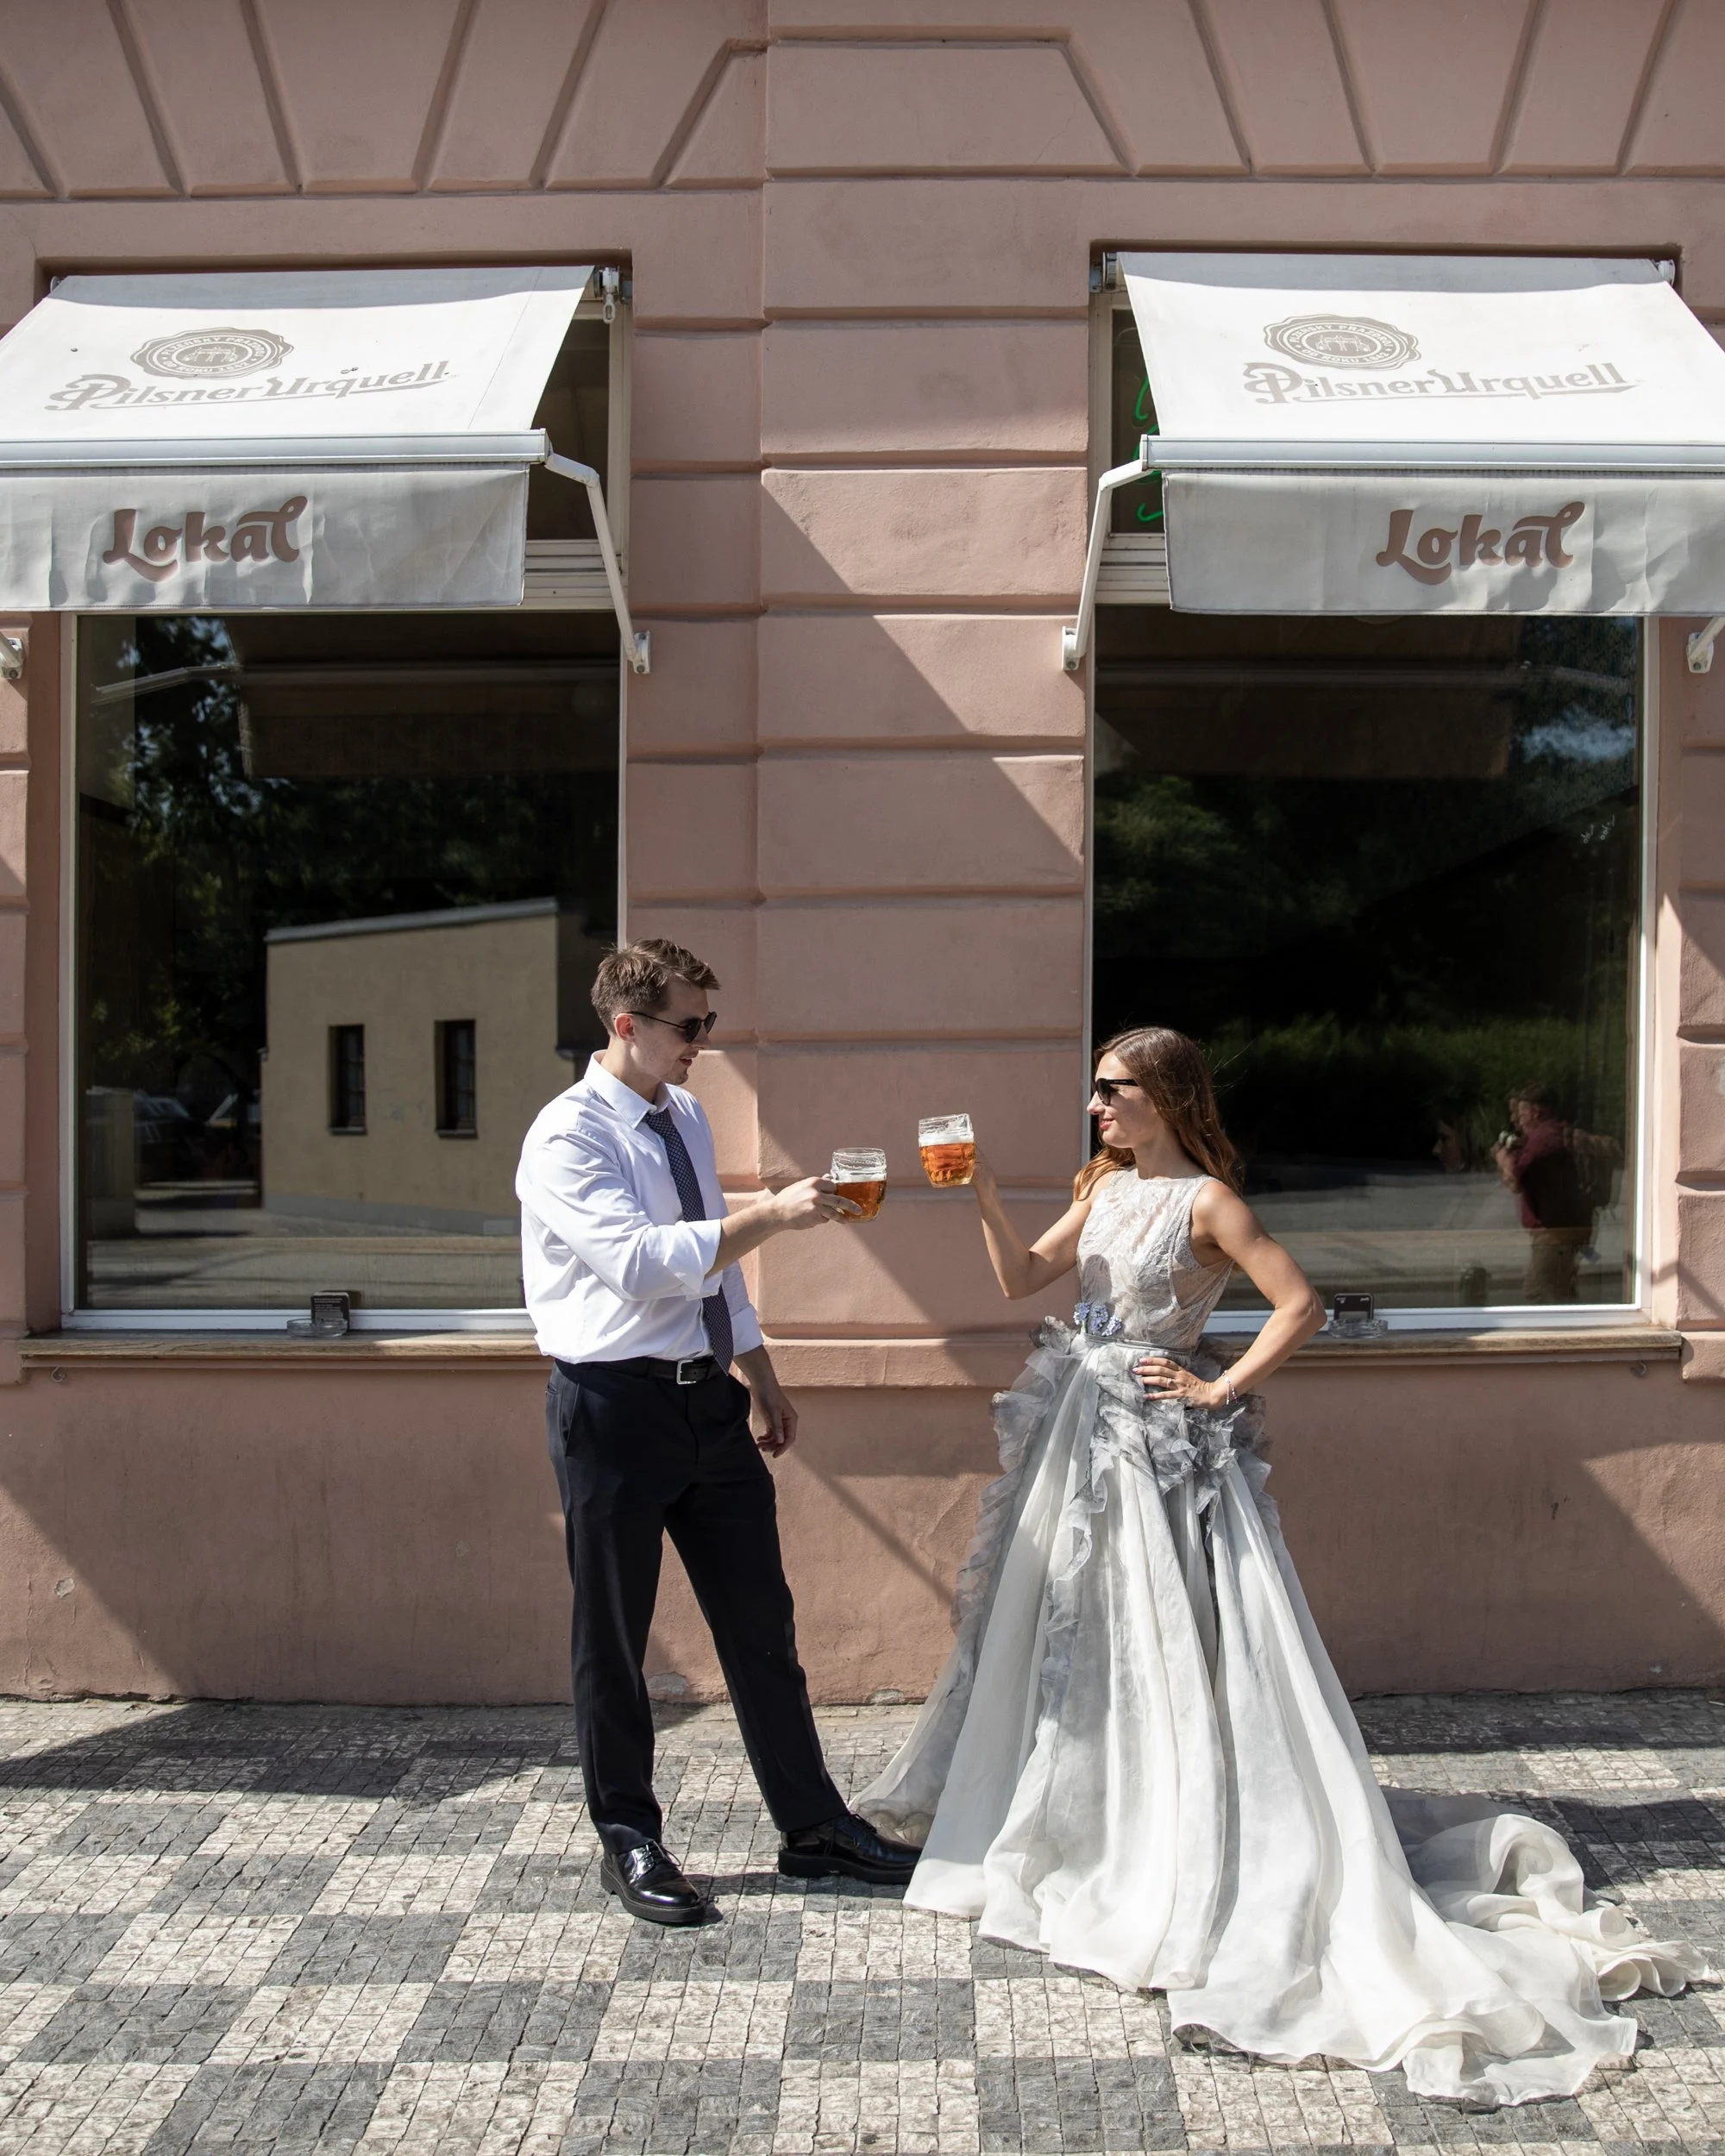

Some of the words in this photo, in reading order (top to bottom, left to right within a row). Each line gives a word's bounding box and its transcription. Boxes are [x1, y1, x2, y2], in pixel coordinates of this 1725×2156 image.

[44, 373, 264, 411] Pilsner
[260, 360, 449, 399] Urquell
[1243, 362, 1435, 404] Pilsner
[1427, 362, 1628, 401] Urquell
